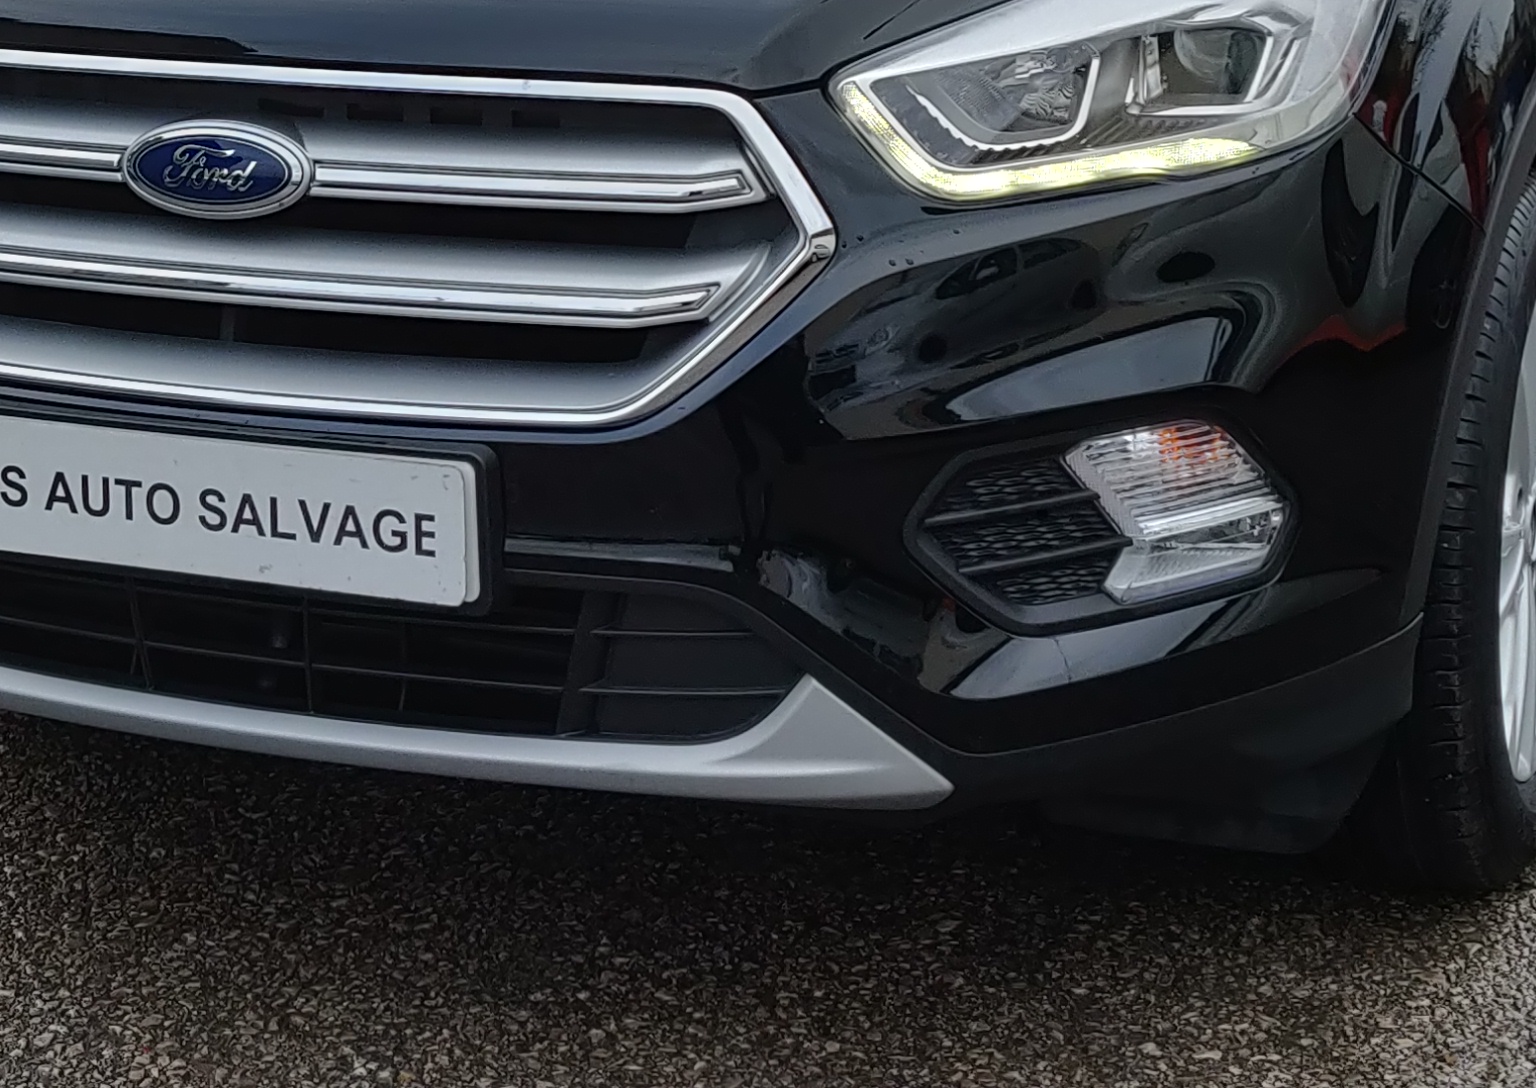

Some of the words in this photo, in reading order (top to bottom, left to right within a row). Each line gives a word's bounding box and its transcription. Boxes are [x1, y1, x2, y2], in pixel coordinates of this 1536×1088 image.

[162, 143, 258, 192] Ford
[44, 470, 181, 526] AUTO
[197, 487, 437, 559] SALVAGE
